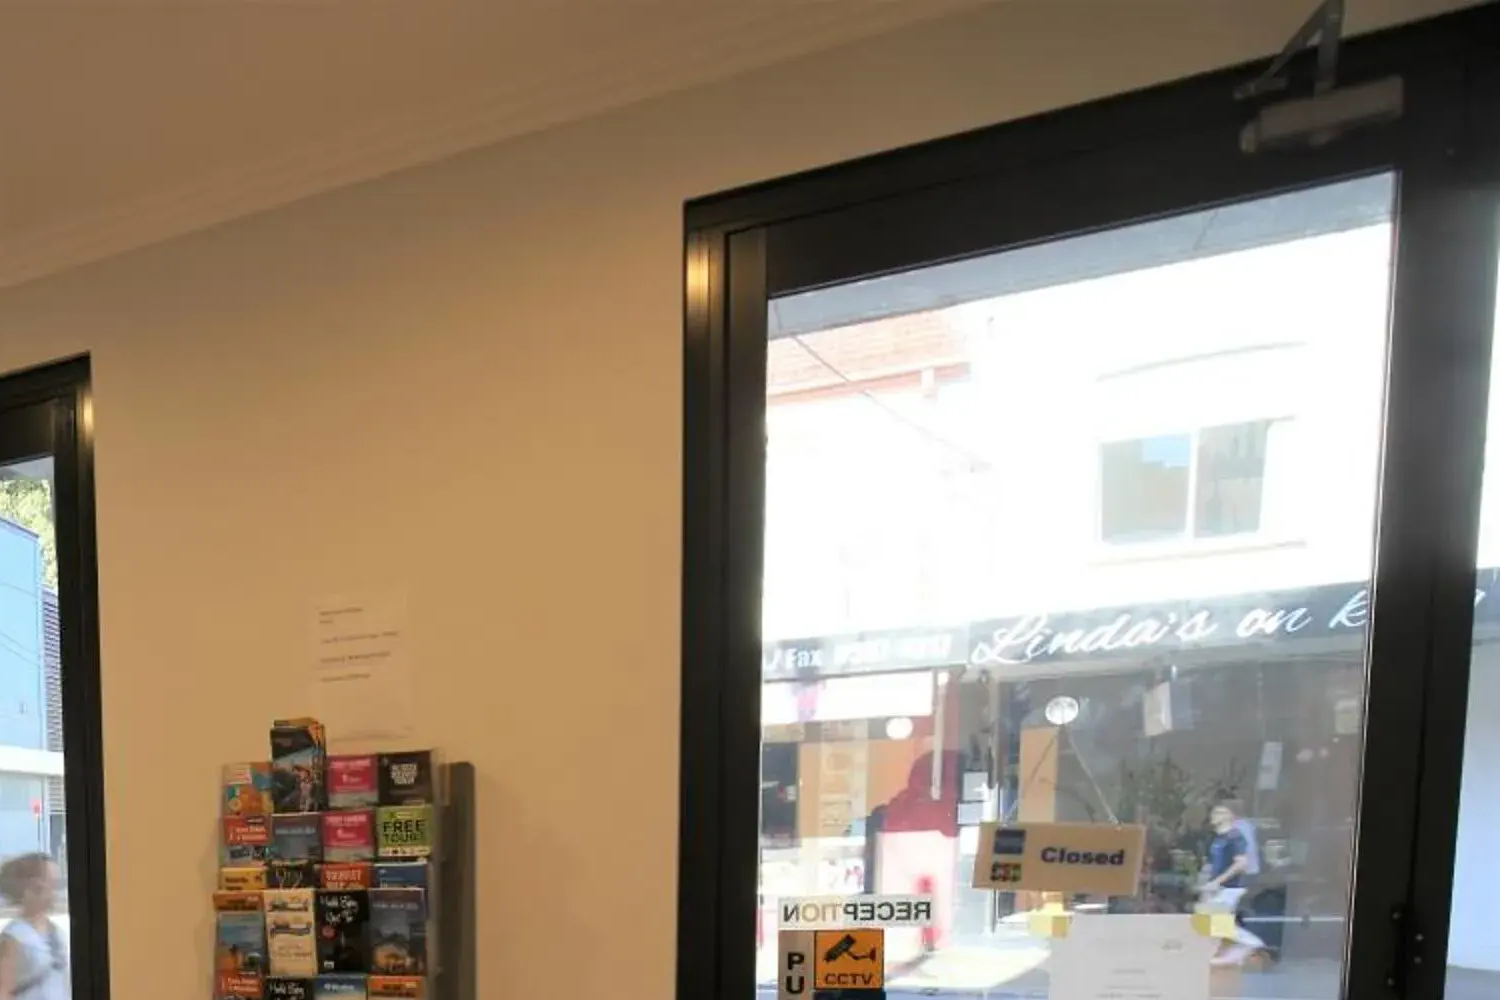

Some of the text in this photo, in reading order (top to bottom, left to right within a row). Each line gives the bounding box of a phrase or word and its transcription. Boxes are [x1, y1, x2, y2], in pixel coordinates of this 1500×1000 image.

[970, 606, 1218, 665] Linda's
[1236, 603, 1313, 638] on
[383, 819, 426, 833] FREE
[1041, 847, 1125, 866] Closed
[825, 973, 873, 985] CCTV
